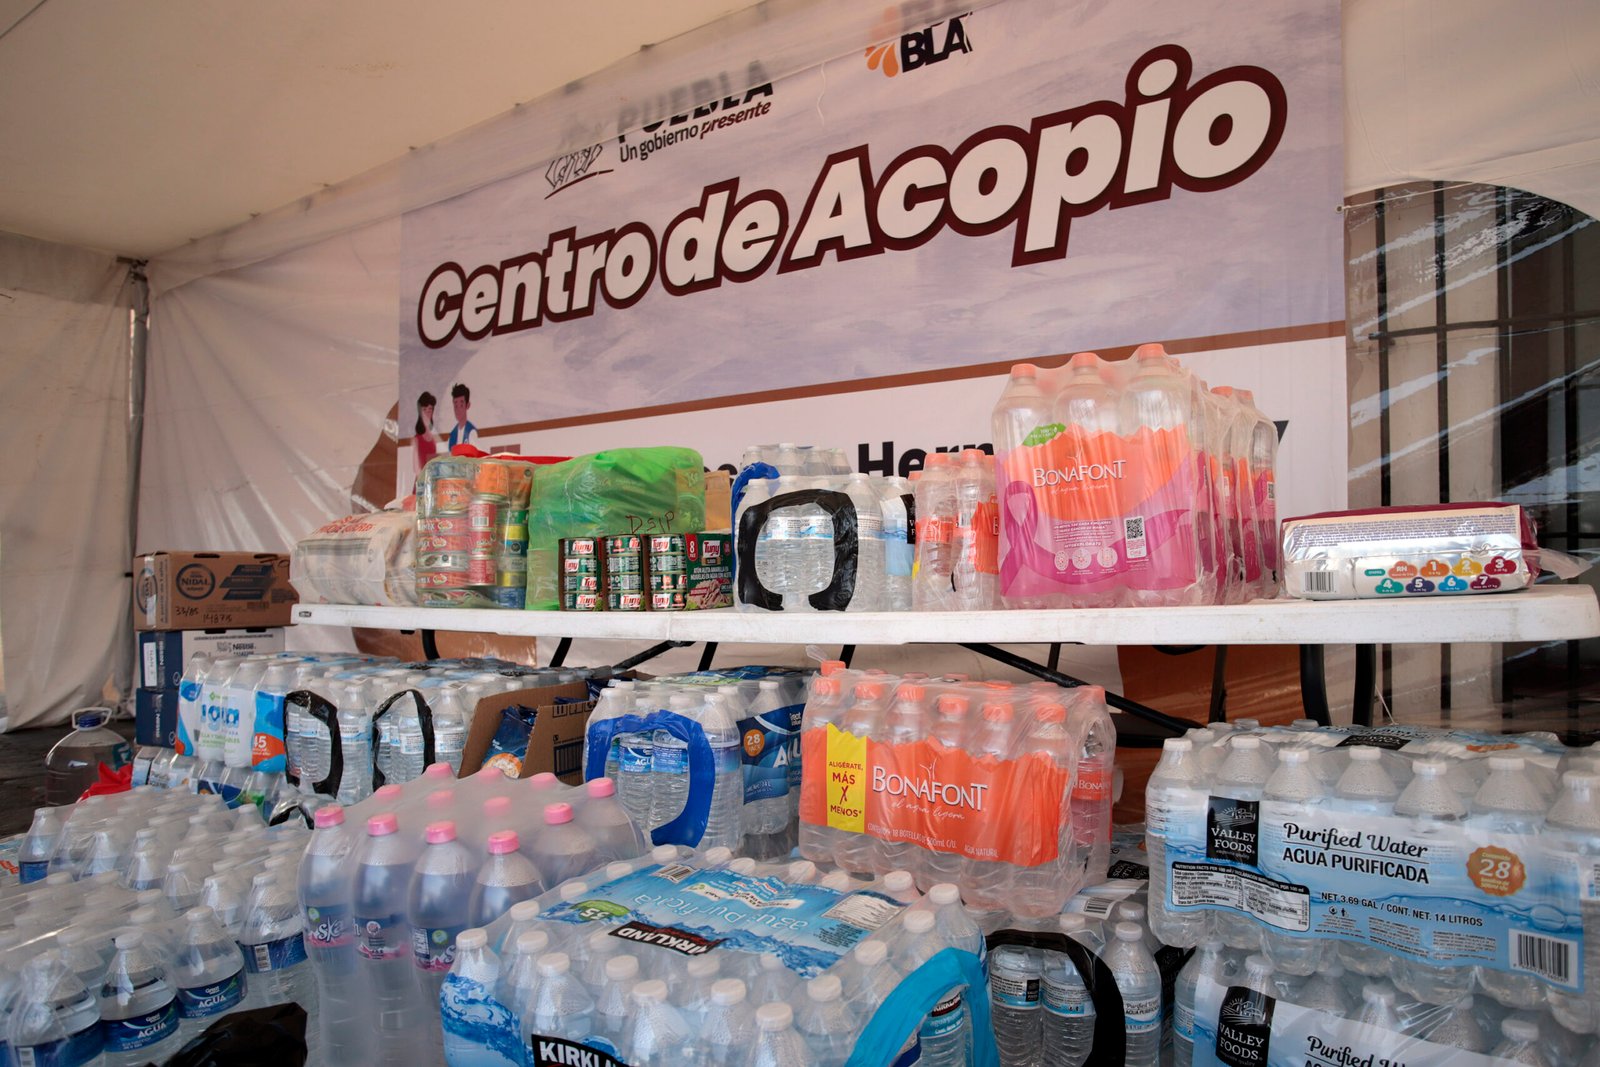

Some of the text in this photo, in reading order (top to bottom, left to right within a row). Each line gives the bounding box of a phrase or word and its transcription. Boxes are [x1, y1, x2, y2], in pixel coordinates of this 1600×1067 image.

[619, 144, 638, 163] Un
[639, 126, 699, 161] gobierno
[700, 101, 772, 139] presente
[417, 44, 1288, 350] Centro de Acopio
[1033, 460, 1126, 488] BONAFONT
[653, 538, 668, 551] Tuny
[690, 541, 695, 553] 8
[704, 541, 720, 557] Tuny
[1432, 560, 1437, 571] 1
[1461, 560, 1471, 570] 2
[1495, 558, 1504, 568] 3
[1383, 579, 1392, 588] 4
[1414, 578, 1423, 587] 5
[1447, 577, 1456, 586] 6
[1479, 576, 1488, 585] 7
[746, 734, 761, 746] 28
[832, 771, 855, 785] MÁS
[872, 766, 988, 811] BONAFONT
[1211, 827, 1256, 843] VALLEY
[1283, 822, 1429, 858] Purified Water
[1215, 838, 1253, 854] FOODS
[1283, 847, 1430, 885] AGUA PURIFICADA
[1479, 858, 1511, 879] 28
[580, 907, 610, 920] 35
[1361, 900, 1378, 910] GAL
[1386, 904, 1411, 917] CONT.
[1413, 910, 1432, 921] NET.
[1435, 914, 1446, 922] 14
[1448, 915, 1483, 927] LITROS
[198, 994, 227, 1009] AGUA
[137, 1022, 167, 1038] AGUA
[1219, 1022, 1265, 1048] VALLEY
[1220, 1037, 1260, 1061] FOODS
[1307, 1035, 1374, 1067] Purified
